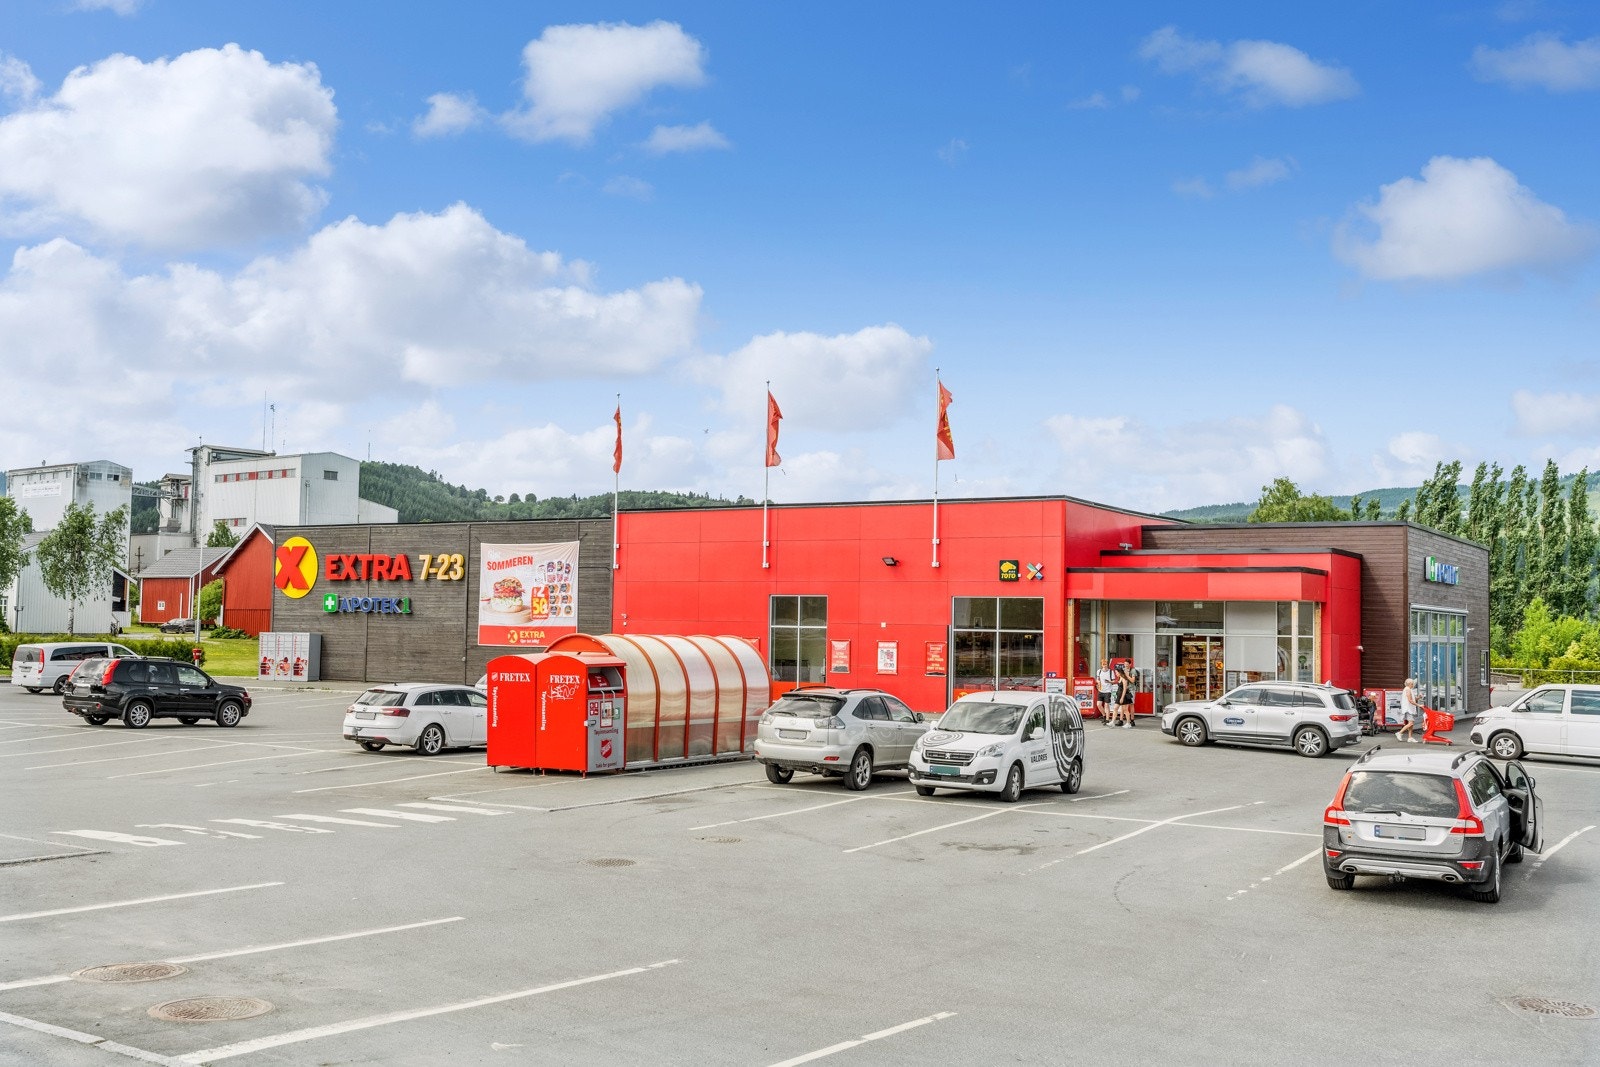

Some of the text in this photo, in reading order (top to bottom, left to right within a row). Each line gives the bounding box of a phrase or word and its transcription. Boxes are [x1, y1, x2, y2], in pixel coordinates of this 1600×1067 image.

[325, 553, 465, 581] EXTRA 7-23
[487, 556, 533, 570] SOMMEREN
[519, 631, 545, 639] EXTRA
[500, 673, 530, 682] FRETEX
[550, 675, 580, 684] FRETEX
